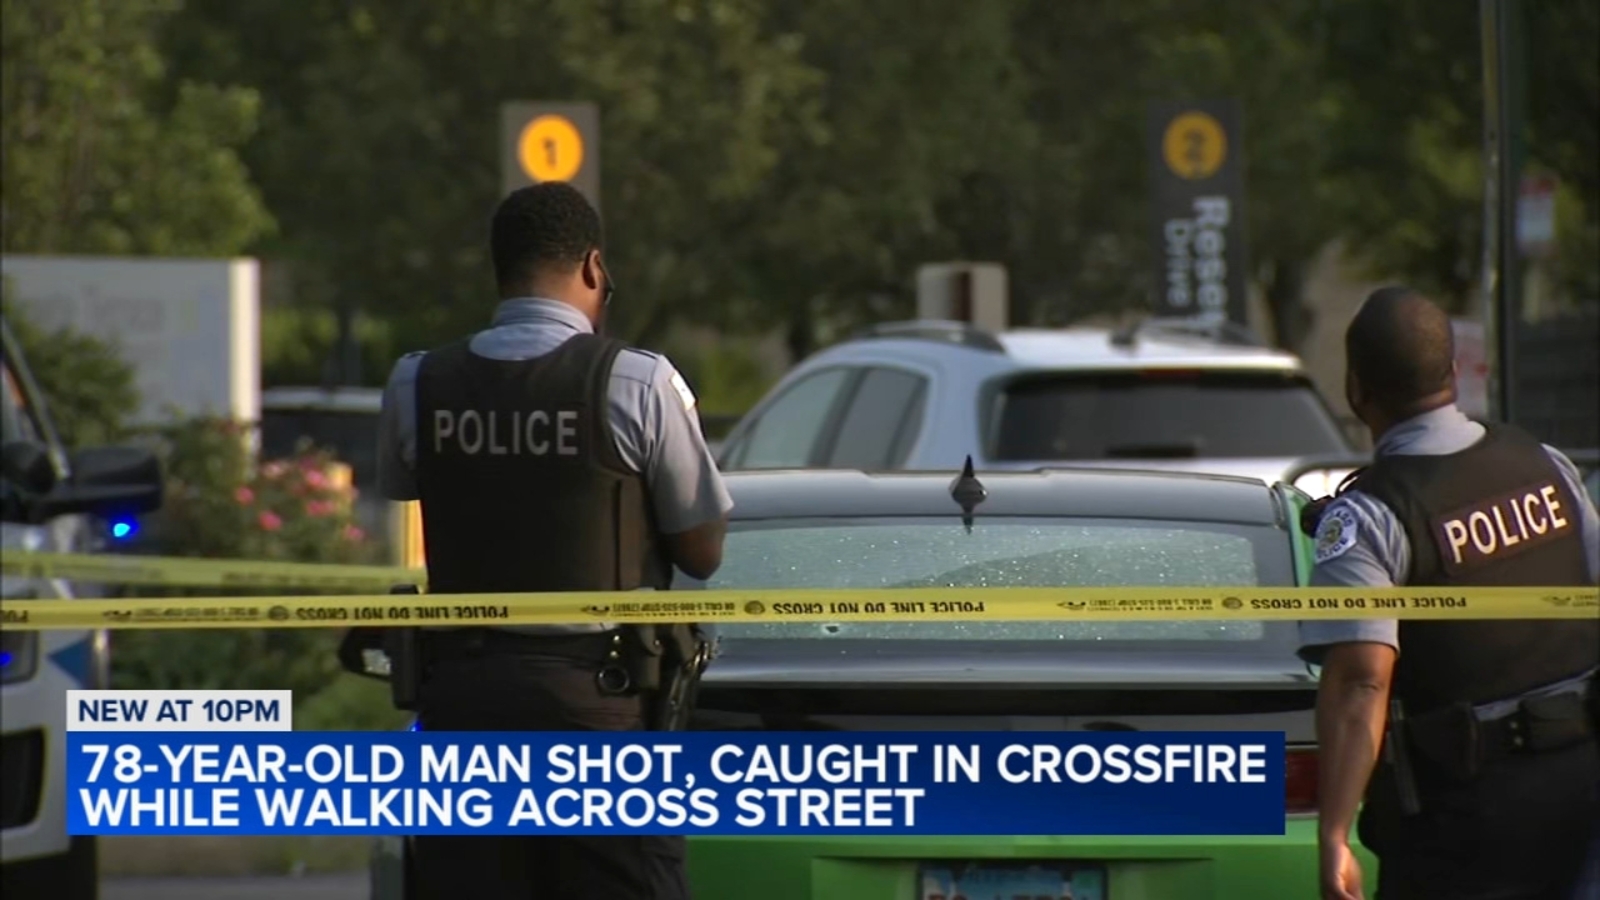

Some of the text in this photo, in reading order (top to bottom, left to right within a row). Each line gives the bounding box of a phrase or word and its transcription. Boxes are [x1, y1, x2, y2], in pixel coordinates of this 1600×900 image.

[434, 409, 578, 455] POLICE
[1444, 485, 1567, 564] POLICE
[772, 601, 984, 615] POLICE LINE DO NOT CROSS
[1250, 597, 1467, 610] POLICE LINE DO NOT CROSS
[295, 605, 509, 621] POLICE LINE DO NOT CROSS
